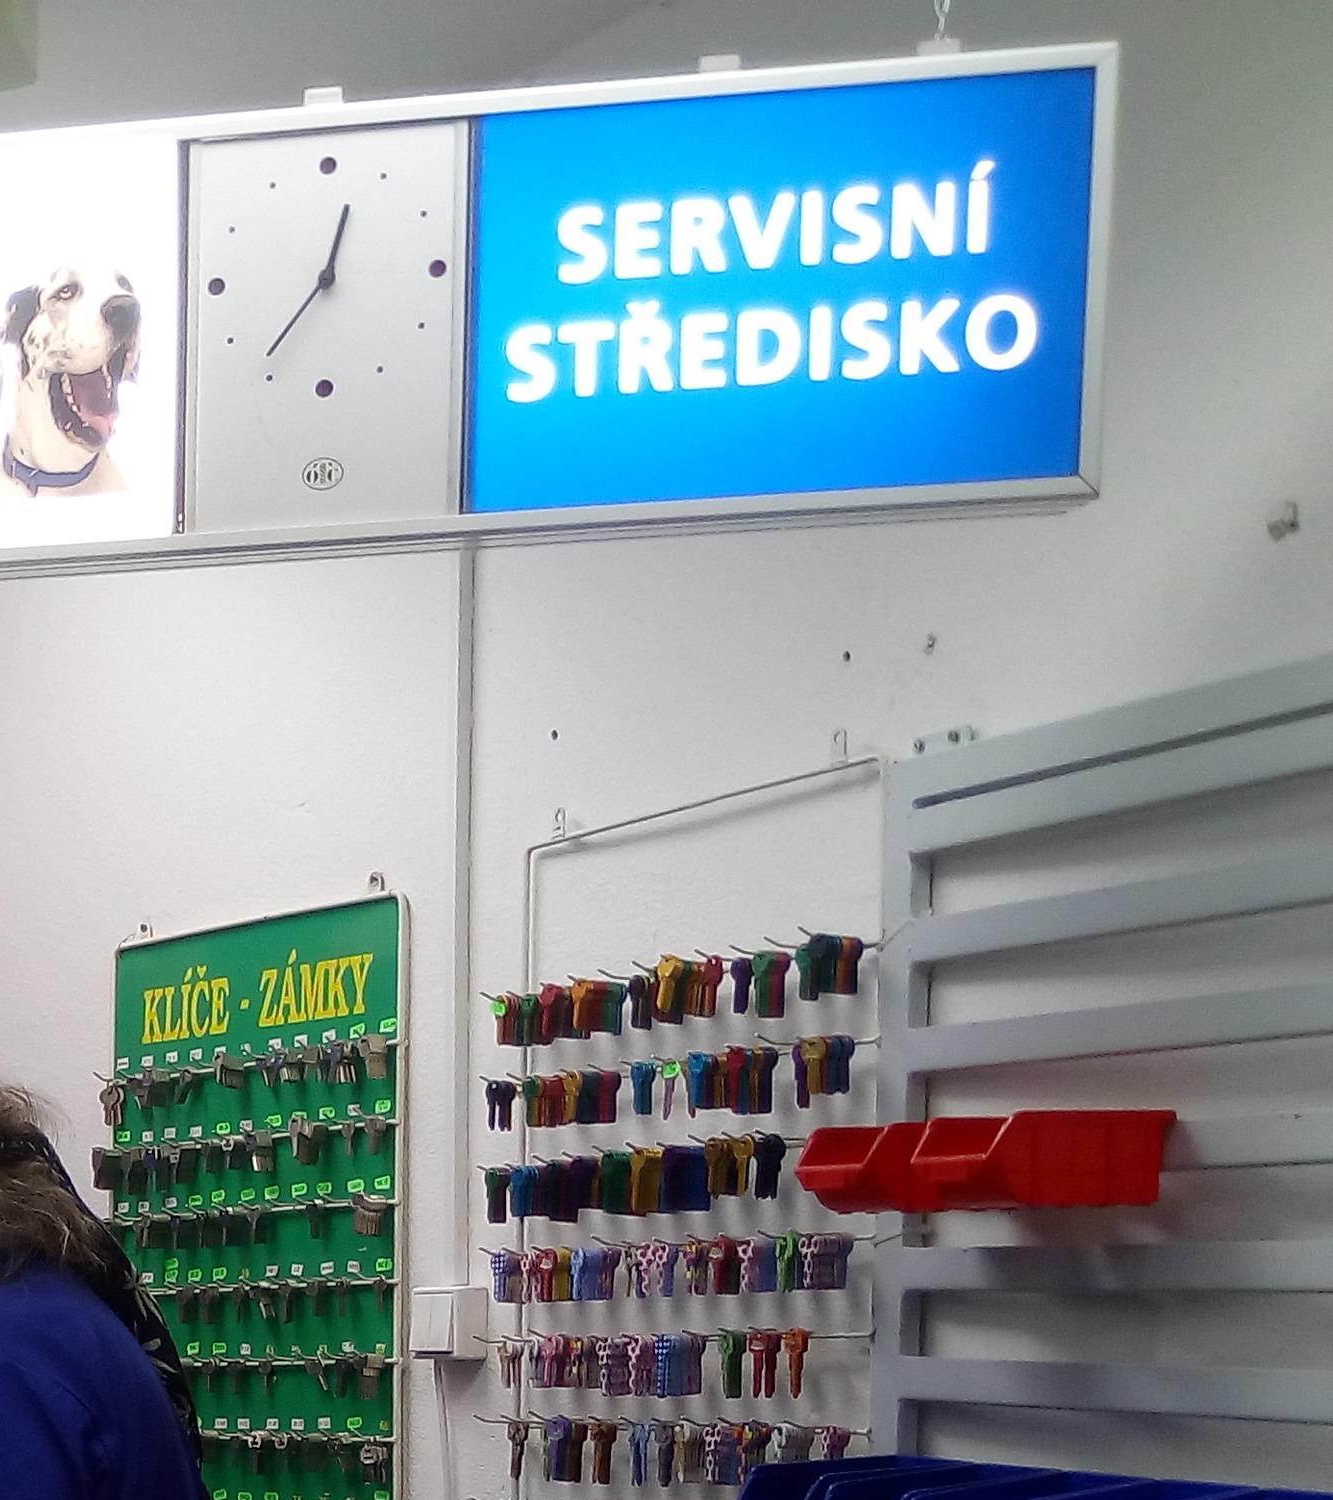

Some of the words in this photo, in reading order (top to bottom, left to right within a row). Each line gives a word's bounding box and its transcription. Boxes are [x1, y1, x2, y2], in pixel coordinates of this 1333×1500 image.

[556, 160, 995, 285] SERVISNÍ
[505, 294, 1037, 403] STŘEDISKO
[141, 965, 230, 1044] KLÍČE
[258, 949, 373, 1028] ZÁMKY
